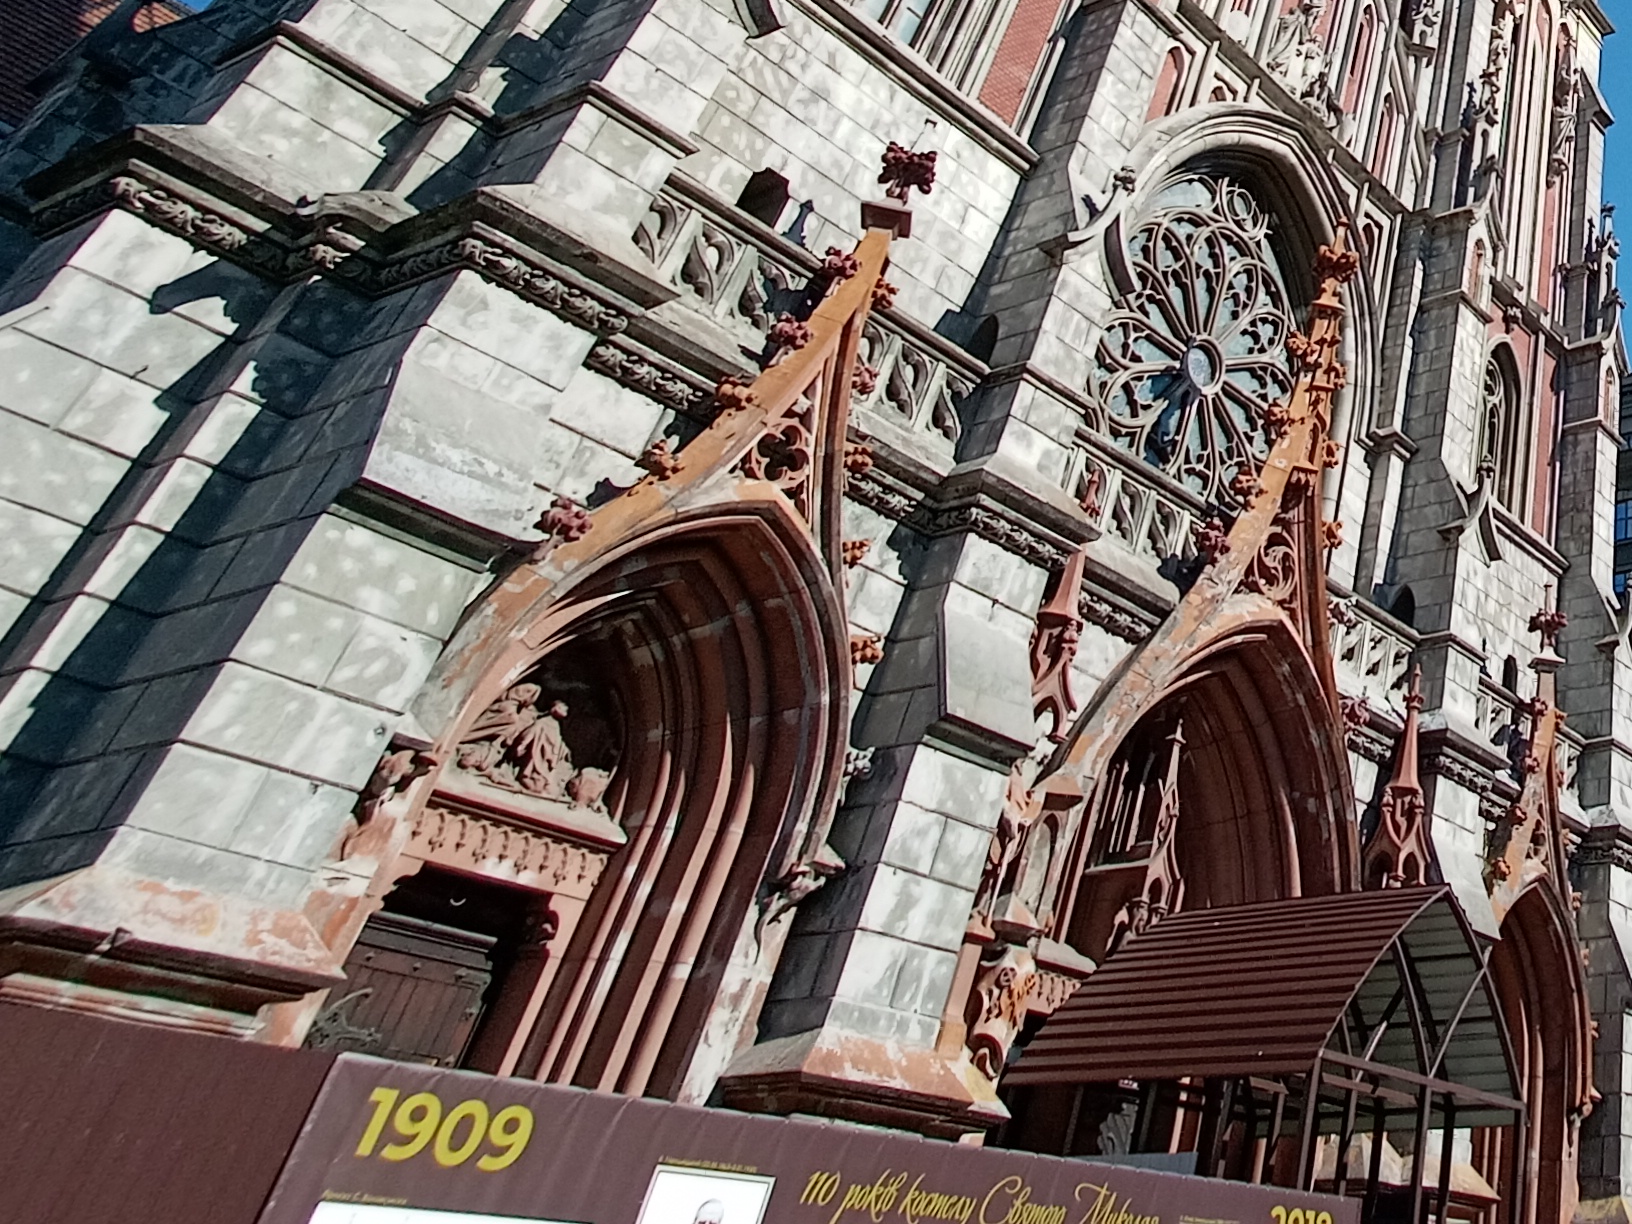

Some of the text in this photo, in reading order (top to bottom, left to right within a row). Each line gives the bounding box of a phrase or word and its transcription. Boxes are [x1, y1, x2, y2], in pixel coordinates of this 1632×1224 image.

[355, 1087, 534, 1172] 1909
[799, 1170, 841, 1206] 110
[829, 1168, 908, 1224] років
[898, 1173, 977, 1224] костелу
[979, 1176, 1067, 1224] Святого
